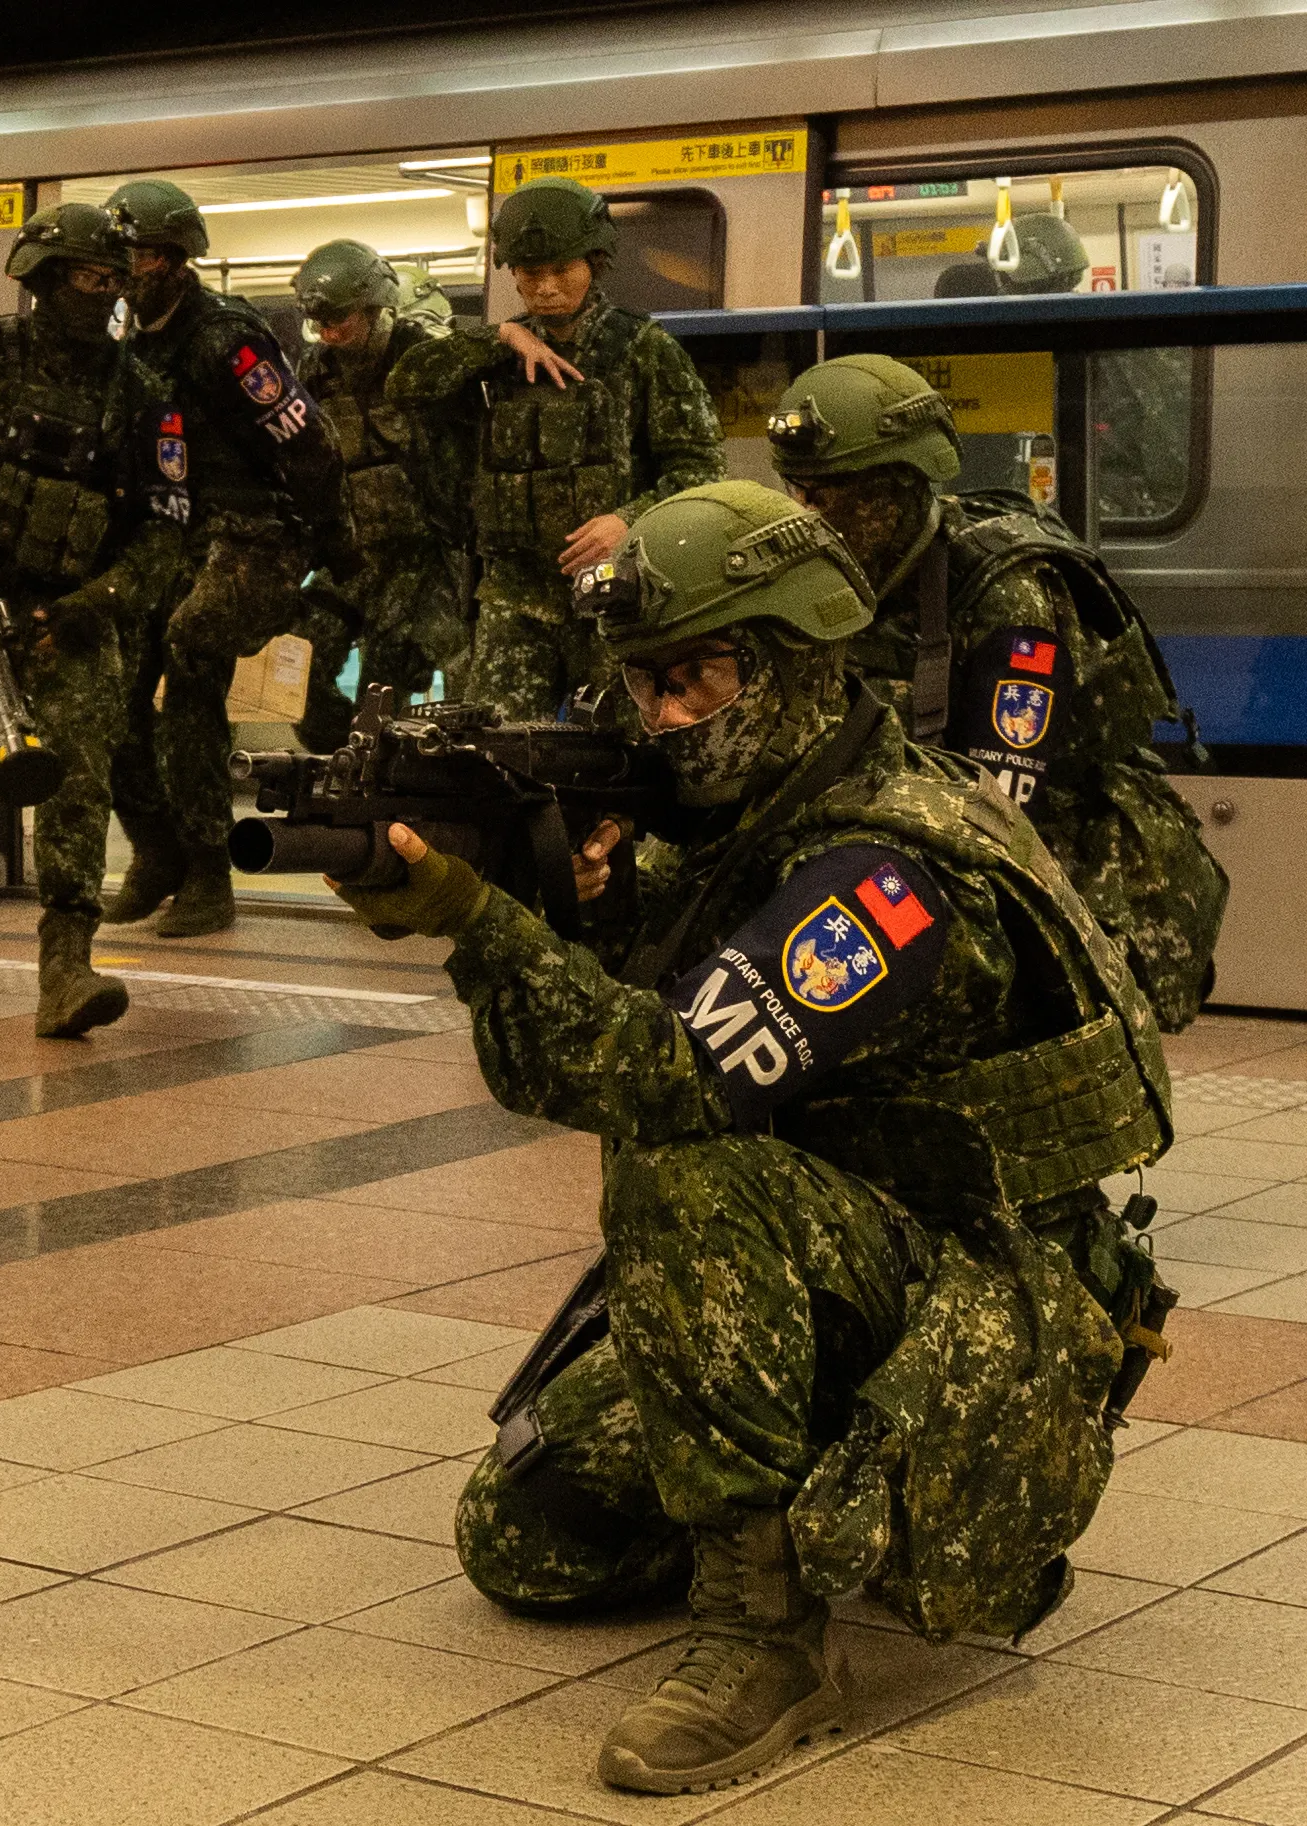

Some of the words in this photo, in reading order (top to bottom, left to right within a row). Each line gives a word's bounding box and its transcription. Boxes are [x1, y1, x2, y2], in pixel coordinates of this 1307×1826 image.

[681, 141, 760, 162] 先下車後上車
[265, 399, 306, 443] MP
[1005, 752, 1035, 770] POLICE
[678, 967, 788, 1086] MP
[760, 988, 802, 1039] POLICE
